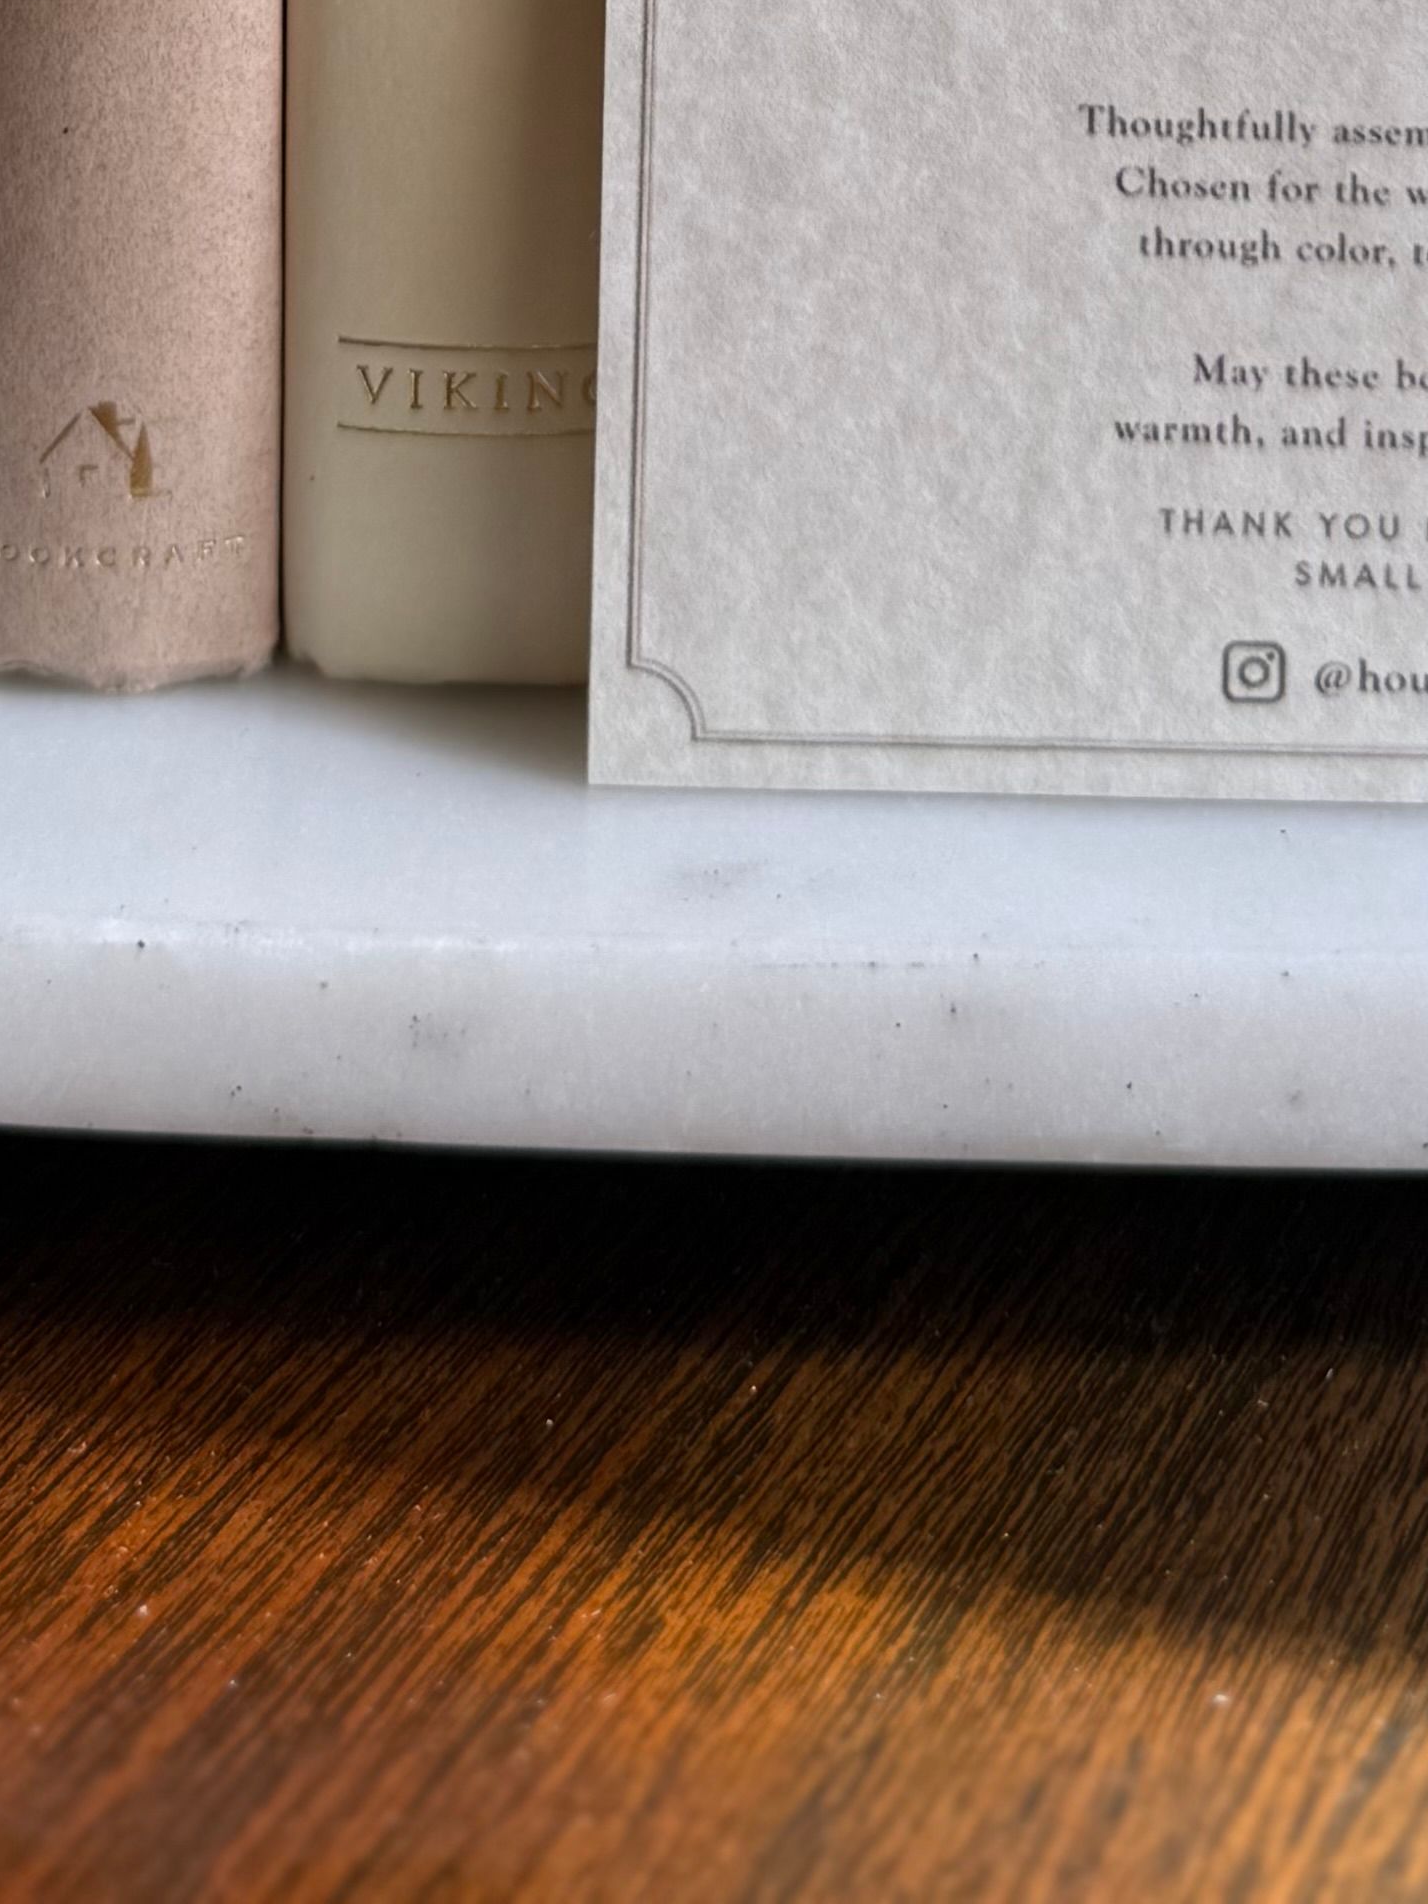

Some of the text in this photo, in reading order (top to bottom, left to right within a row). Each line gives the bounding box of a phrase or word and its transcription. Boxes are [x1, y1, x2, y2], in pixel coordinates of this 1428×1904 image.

[1078, 103, 1315, 148] Thoughtfully
[1115, 165, 1251, 202] Chosen
[1269, 170, 1321, 204] for
[1335, 172, 1391, 206] the
[1139, 226, 1281, 267] through
[1296, 232, 1396, 268] color,
[1193, 353, 1269, 390] May
[1285, 356, 1380, 392] these
[1114, 414, 1264, 449] warmth,
[1281, 417, 1347, 449] and
[1159, 508, 1292, 539] THANK
[1319, 512, 1401, 541] YOU
[1295, 560, 1421, 591] SMALL
